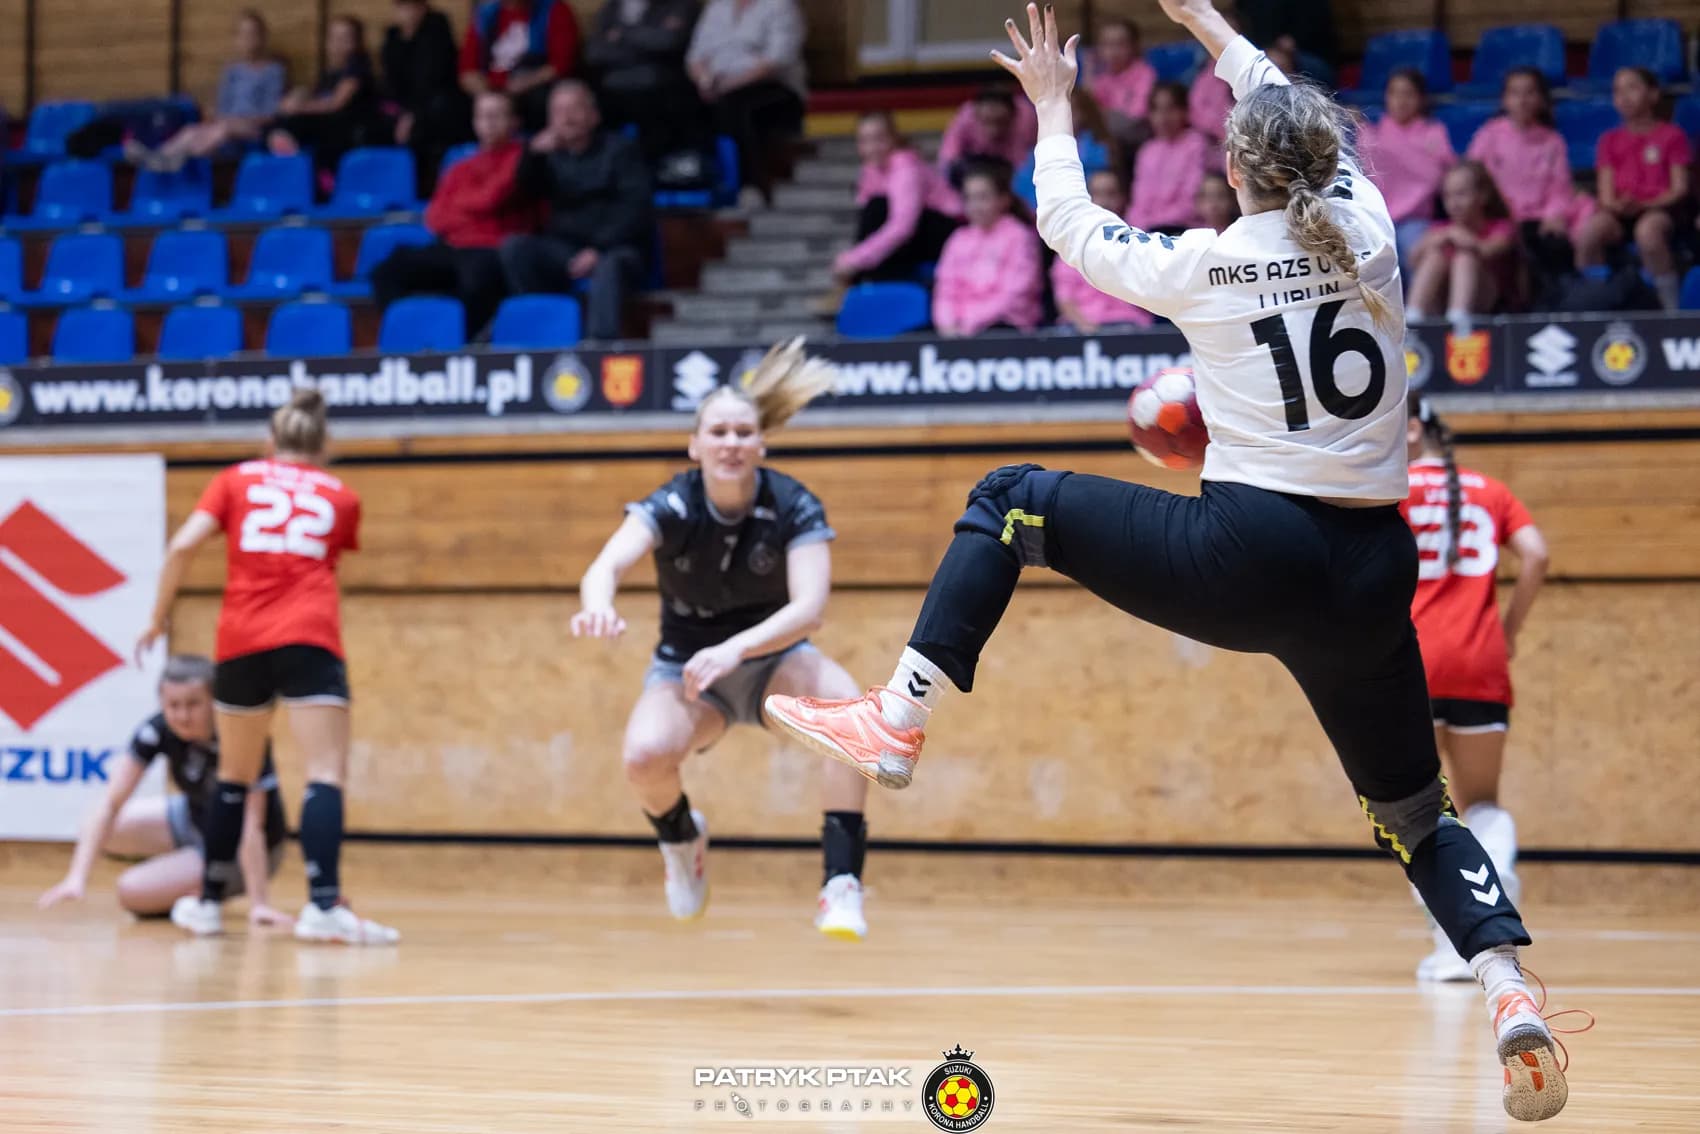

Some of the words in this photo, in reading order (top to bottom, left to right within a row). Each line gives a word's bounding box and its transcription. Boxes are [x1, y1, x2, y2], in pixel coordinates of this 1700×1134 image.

[1209, 264, 1258, 286] MKS
[1267, 257, 1311, 281] AZS
[31, 354, 532, 414] www.koronahandball.pl
[1250, 299, 1386, 432] 16
[241, 484, 335, 560] 22
[1408, 504, 1498, 580] 33
